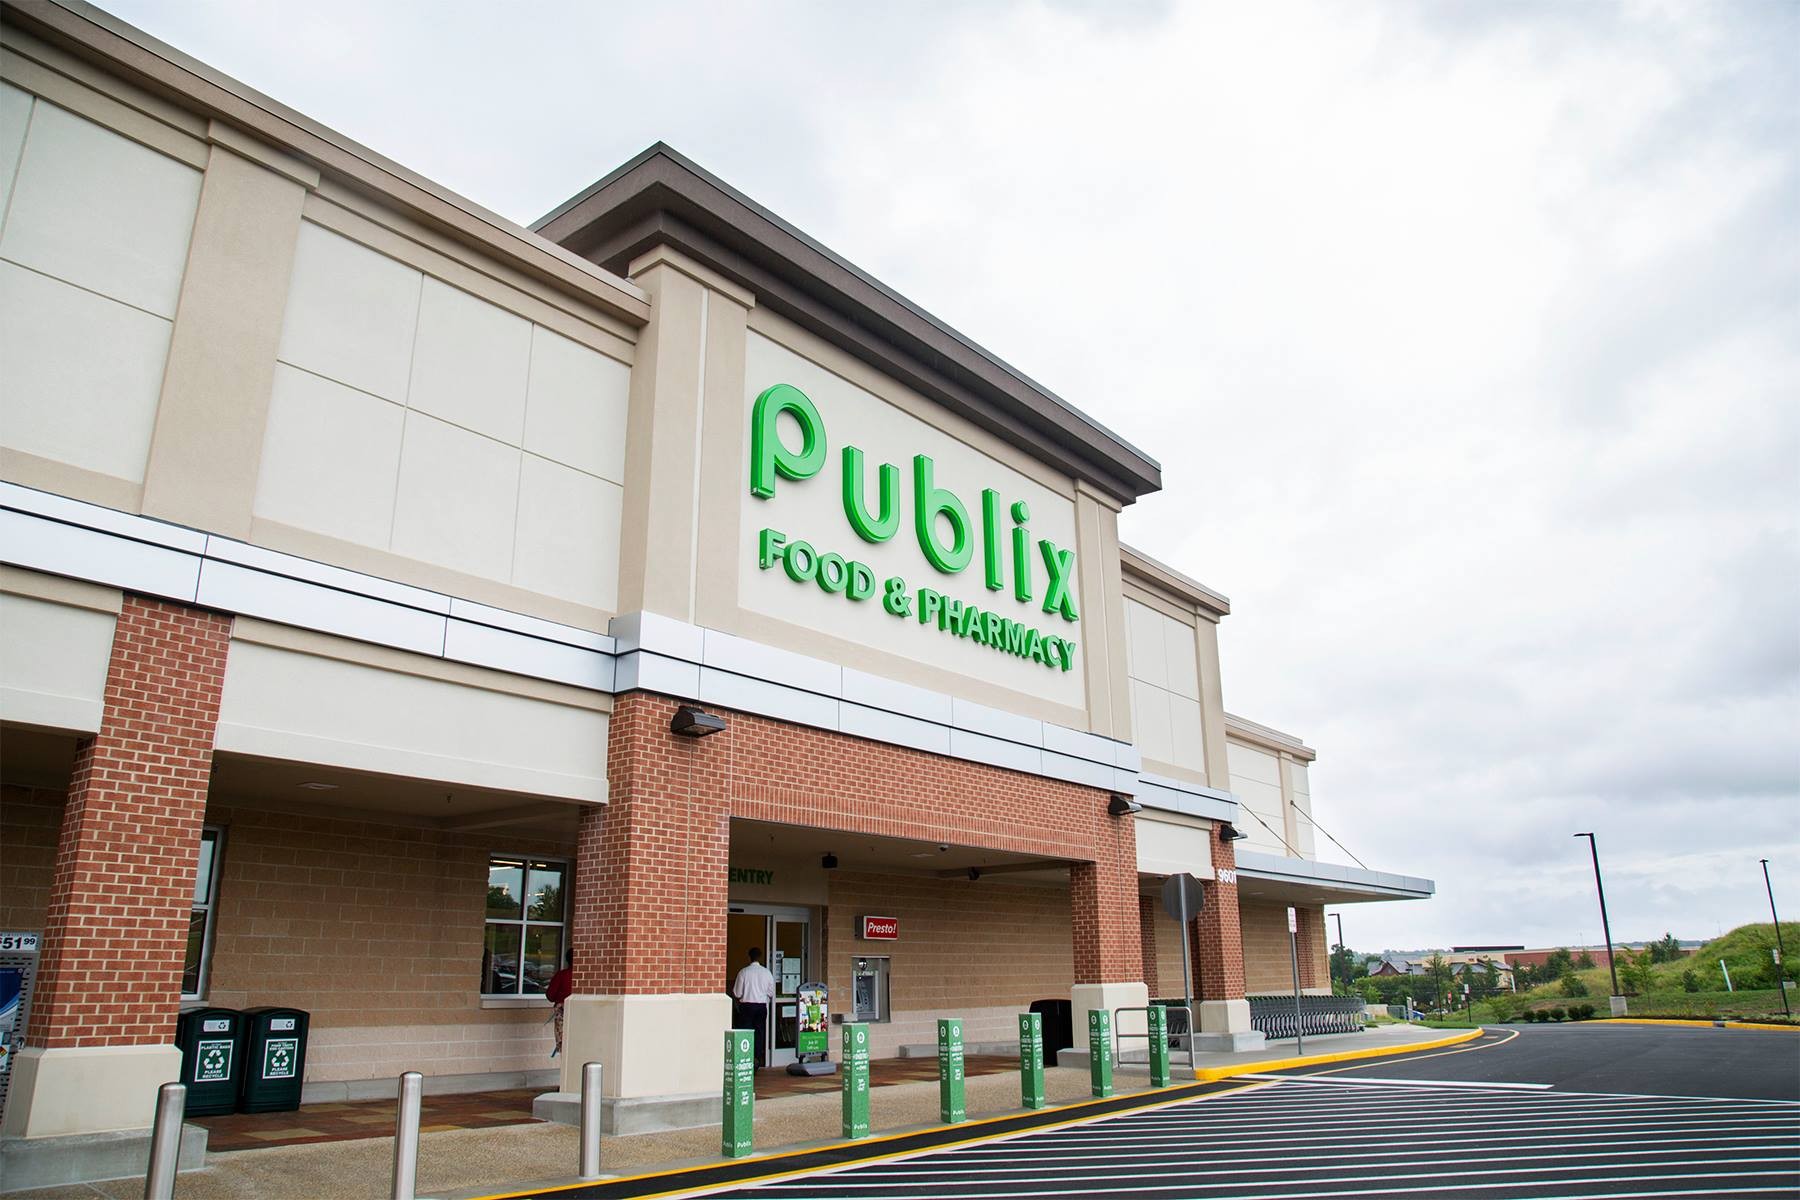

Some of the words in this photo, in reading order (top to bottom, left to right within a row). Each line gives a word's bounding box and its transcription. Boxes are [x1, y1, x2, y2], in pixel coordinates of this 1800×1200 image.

[750, 383, 1079, 622] Publix
[759, 527, 876, 602] FOOD
[882, 576, 912, 618] &
[918, 587, 1077, 672] PHARMACY
[729, 867, 774, 885] ENTRY
[1218, 867, 1237, 884] 9601
[867, 922, 896, 934] Presto!
